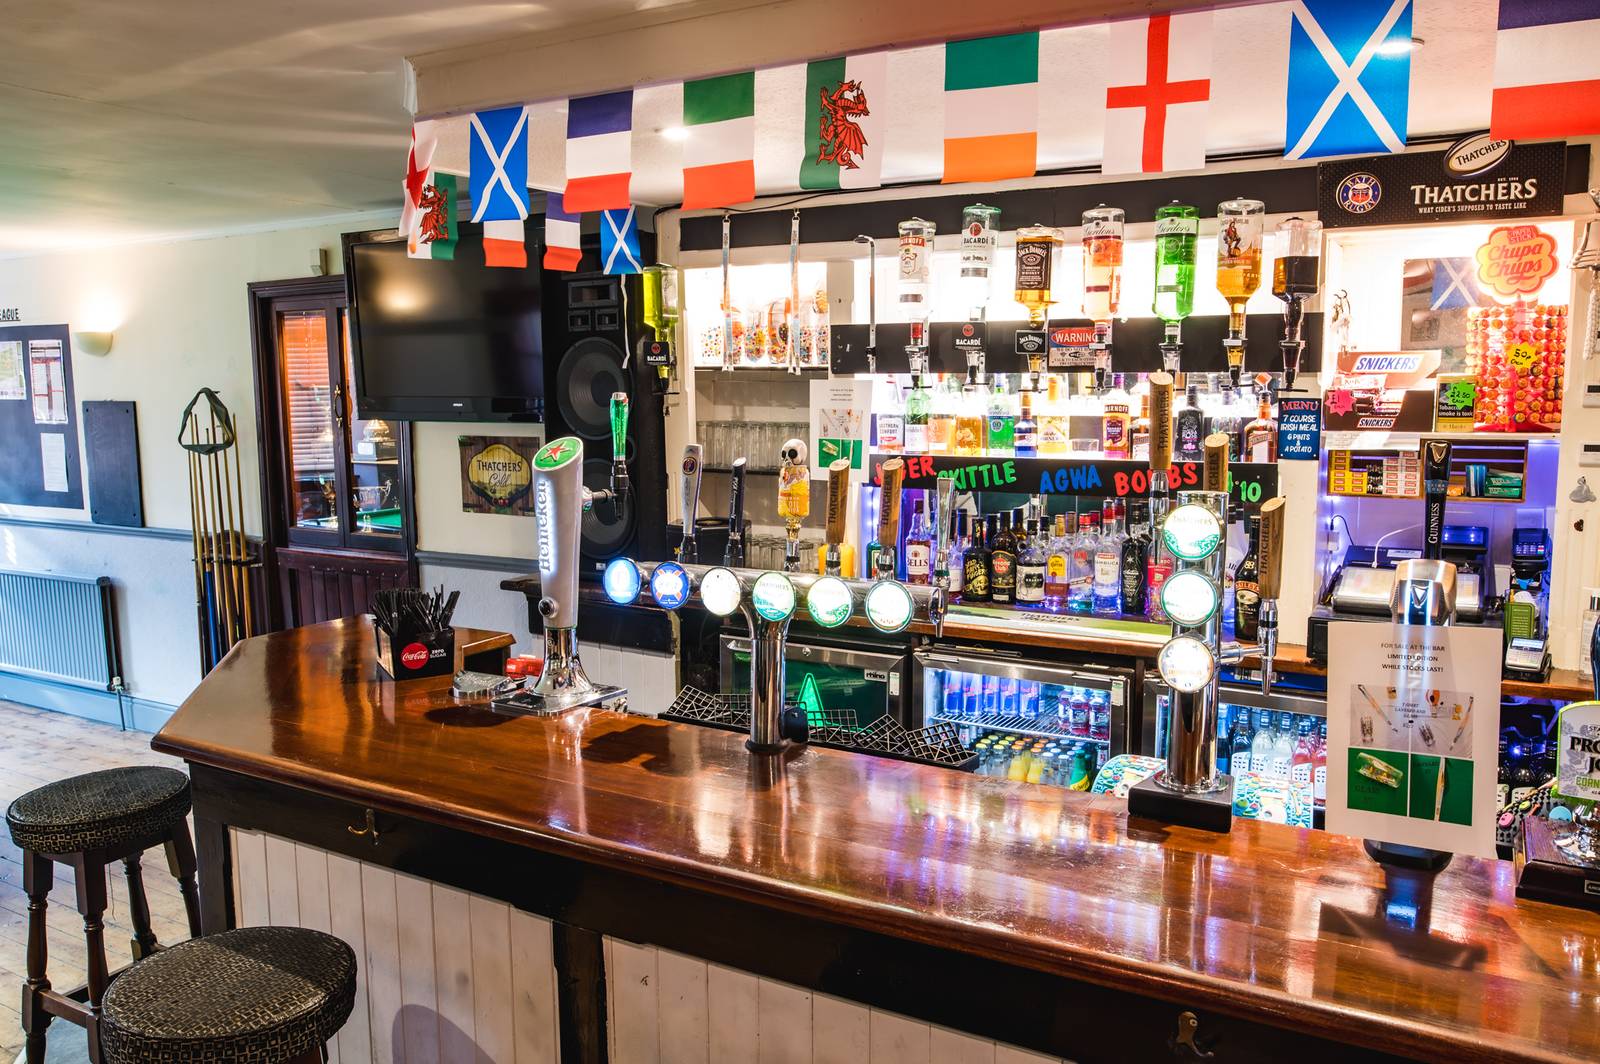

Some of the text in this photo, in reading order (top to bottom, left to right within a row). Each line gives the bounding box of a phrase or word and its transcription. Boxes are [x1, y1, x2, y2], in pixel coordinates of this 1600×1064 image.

[1455, 139, 1507, 166] THATCHERS
[1345, 176, 1377, 187] BATH
[1410, 178, 1538, 205] THATCHERS
[1343, 200, 1376, 213] RUGBY
[1435, 205, 1456, 213] CIDER'S
[1457, 204, 1485, 212] SUPPOSED
[1488, 243, 1543, 262] Chupa
[1488, 258, 1543, 283] Chups
[1055, 332, 1097, 343] WARNING
[1356, 356, 1418, 371] SNICKERS
[1281, 401, 1319, 411] MENU
[1158, 391, 1169, 450] THATCHERS
[1283, 414, 1316, 423] 7 COURSE
[1359, 418, 1393, 427] SNICKERS
[1280, 423, 1318, 431] IRISH MEAL
[477, 459, 522, 472] THATCHERS
[488, 472, 512, 489] Gold
[1039, 464, 1102, 494] AGWA
[1113, 462, 1198, 496] BOBS
[828, 475, 840, 524] THATCHERS
[881, 475, 893, 525] THATCHERS
[538, 480, 551, 572] Heineken
[1427, 502, 1440, 544] GUINNESS
[1259, 516, 1271, 575] THATCHERS
[402, 650, 427, 662] Coca-Cola
[866, 671, 885, 679] rhino
